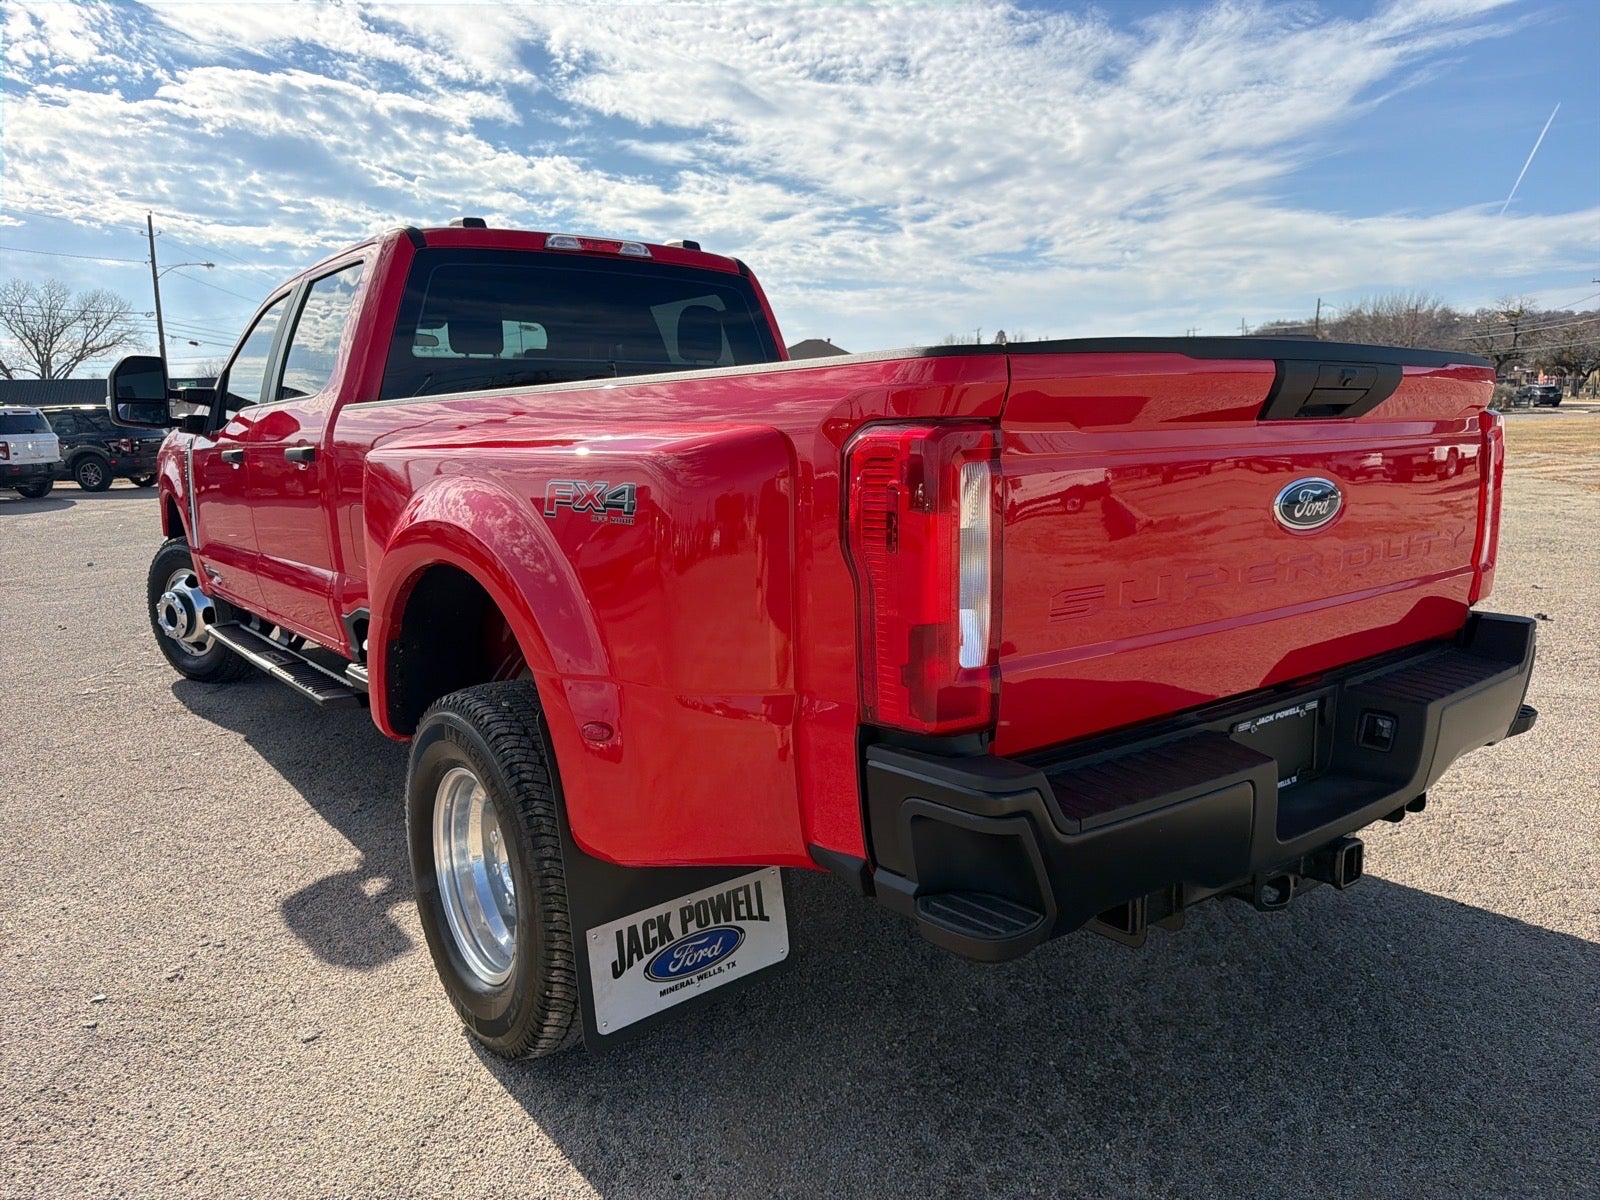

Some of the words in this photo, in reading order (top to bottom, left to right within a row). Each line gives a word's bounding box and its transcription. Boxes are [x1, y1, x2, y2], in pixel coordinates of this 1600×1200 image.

[544, 479, 637, 517] FX4
[1294, 489, 1330, 518] Ford
[1049, 553, 1323, 623] SUPER
[1339, 526, 1466, 572] DUTY
[1256, 714, 1275, 726] JACK
[1275, 706, 1300, 720] POWELL
[611, 912, 675, 980] JACK
[679, 880, 770, 936] POWELL
[668, 937, 725, 973] Ford
[659, 979, 695, 998] MINERAL
[697, 966, 725, 983] WELLS,
[726, 960, 737, 970] TX
